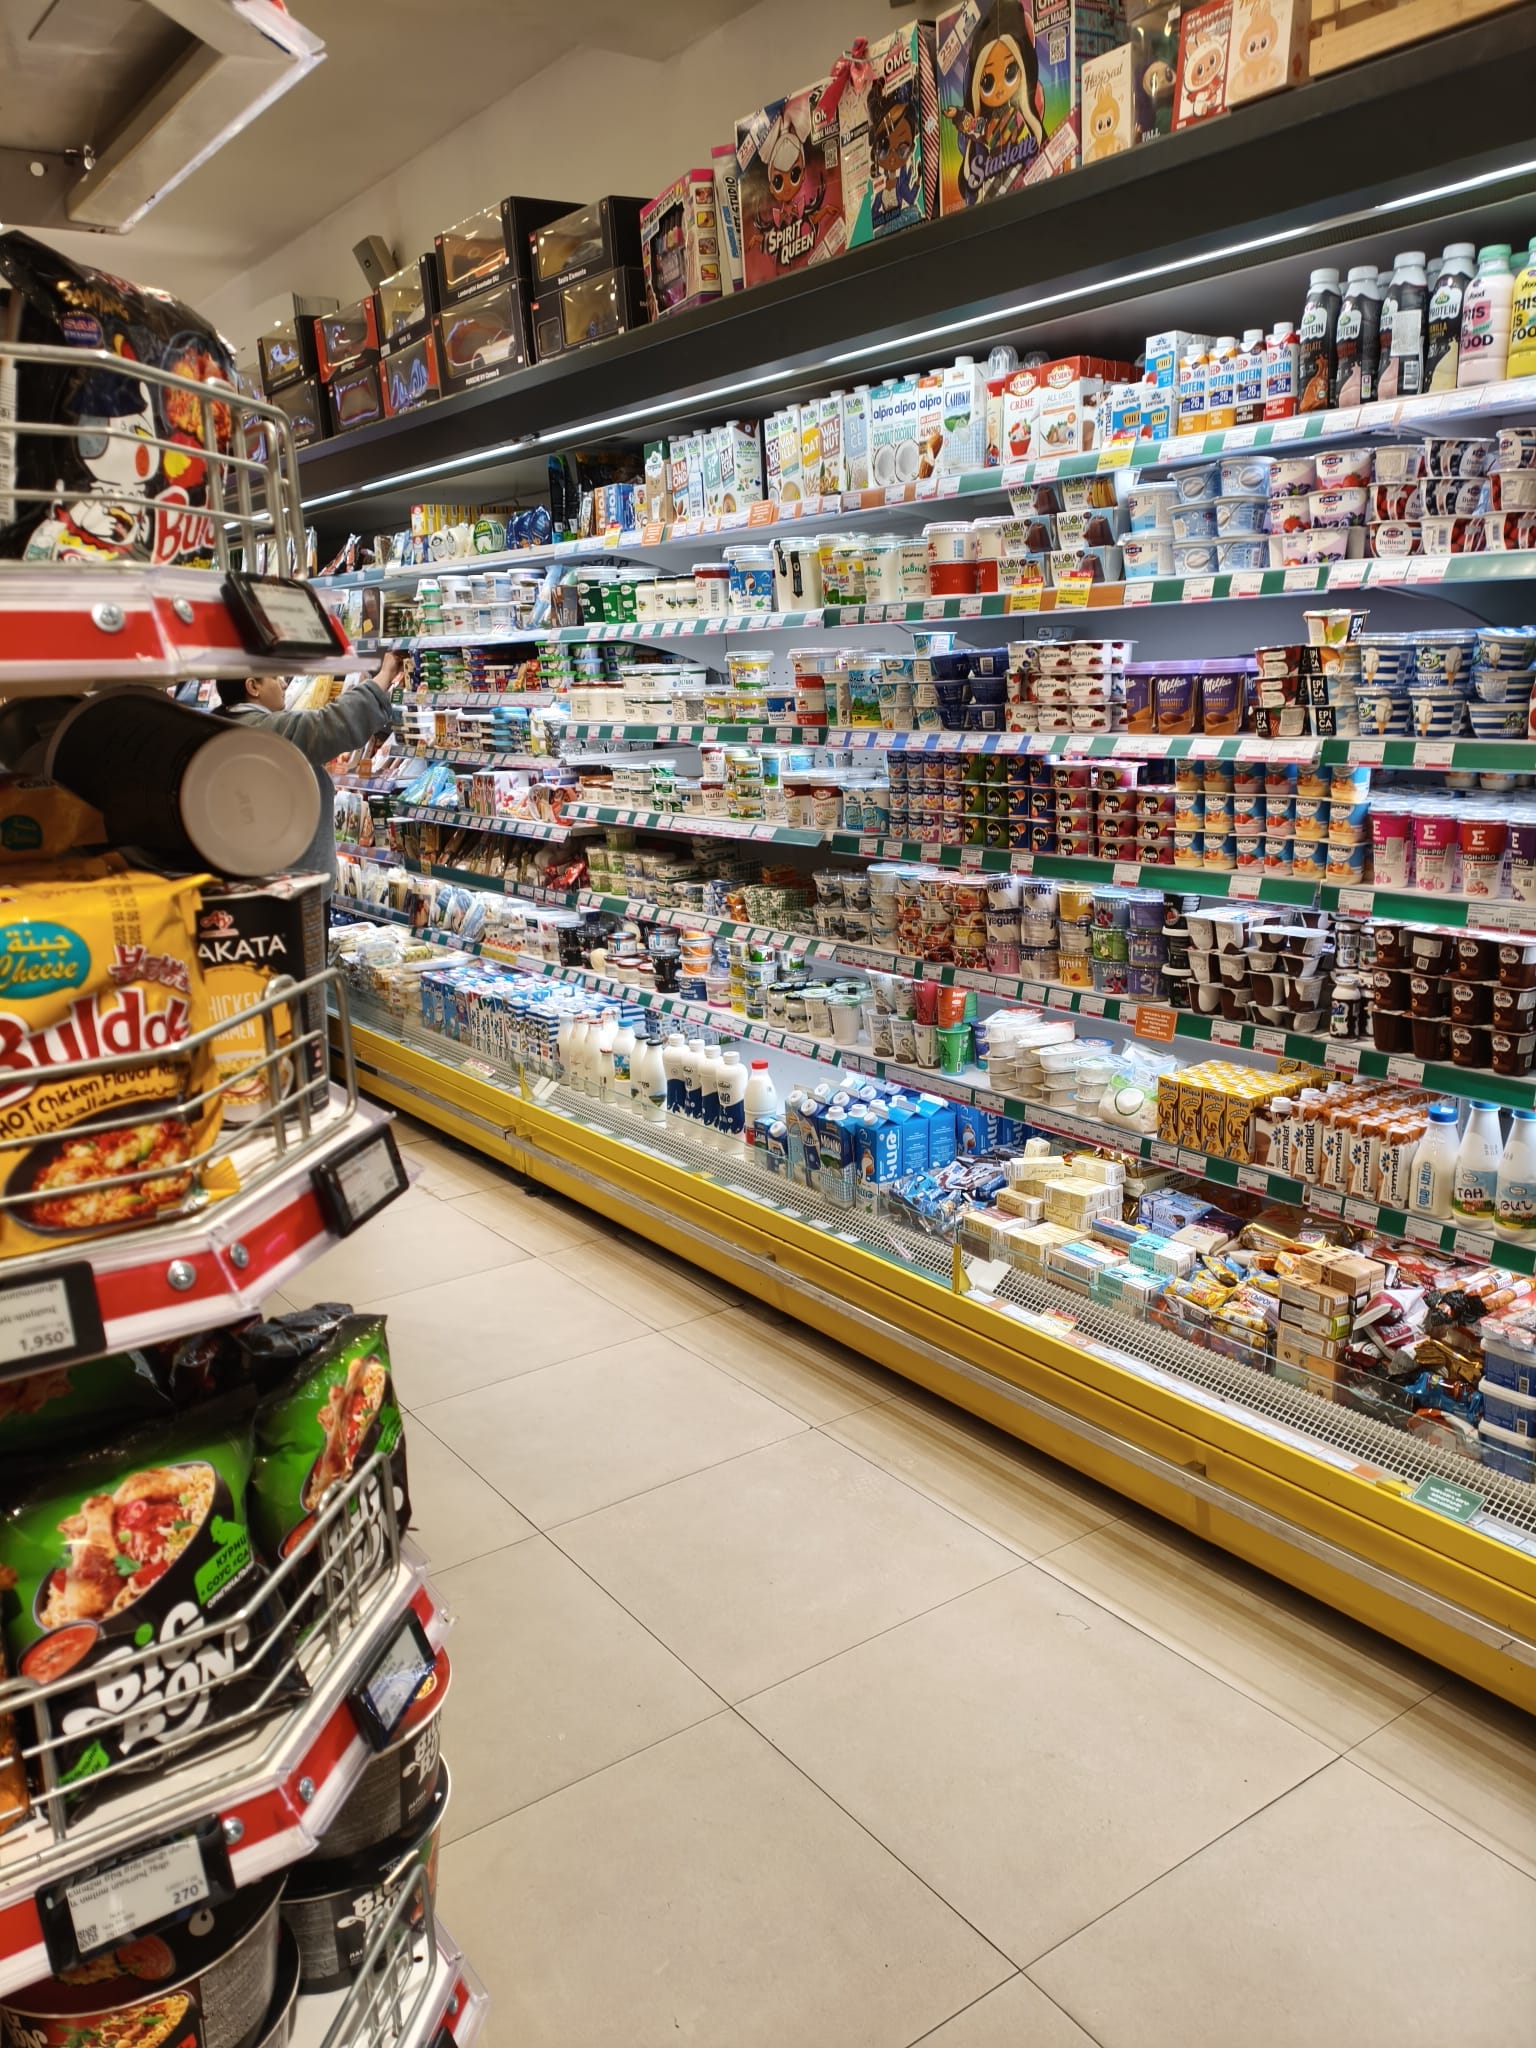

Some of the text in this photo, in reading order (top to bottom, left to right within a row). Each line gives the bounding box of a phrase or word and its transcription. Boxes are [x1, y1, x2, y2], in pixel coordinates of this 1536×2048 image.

[1051, 9, 1070, 25] MAGIC
[885, 48, 911, 74] OMG
[968, 137, 1038, 189] Starlette
[768, 220, 803, 253] SPIRIT
[781, 231, 814, 264] QUEEN
[1513, 313, 1524, 328] IS
[895, 400, 917, 416] alpro
[920, 394, 942, 412] alpro
[873, 405, 894, 421] alpro
[803, 436, 819, 457] OAT
[823, 434, 840, 452] NUT
[672, 472, 688, 487] OND
[1058, 515, 1084, 526] VALSOIA
[1052, 553, 1077, 564] VALSOIA
[1157, 677, 1187, 695] Milka
[1203, 676, 1233, 694] Milka
[1312, 689, 1325, 699] CA
[1256, 720, 1267, 730] CA
[1318, 719, 1332, 729] CA
[987, 914, 1018, 927] yogurt
[7, 929, 72, 958] جبنة
[37, 1080, 99, 1112] Chicken
[103, 1066, 151, 1089] Flavor
[1282, 1125, 1290, 1173] parmalat
[1305, 1122, 1316, 1175] parmalat
[1335, 1132, 1346, 1184] parmalat
[1363, 1141, 1374, 1193] parmalat
[1391, 1148, 1403, 1201] parmalat
[1457, 1187, 1484, 1199] ТАН
[19, 1330, 65, 1353] 1,950
[206, 1563, 232, 1592] СОУС
[173, 1885, 199, 1905] 270
